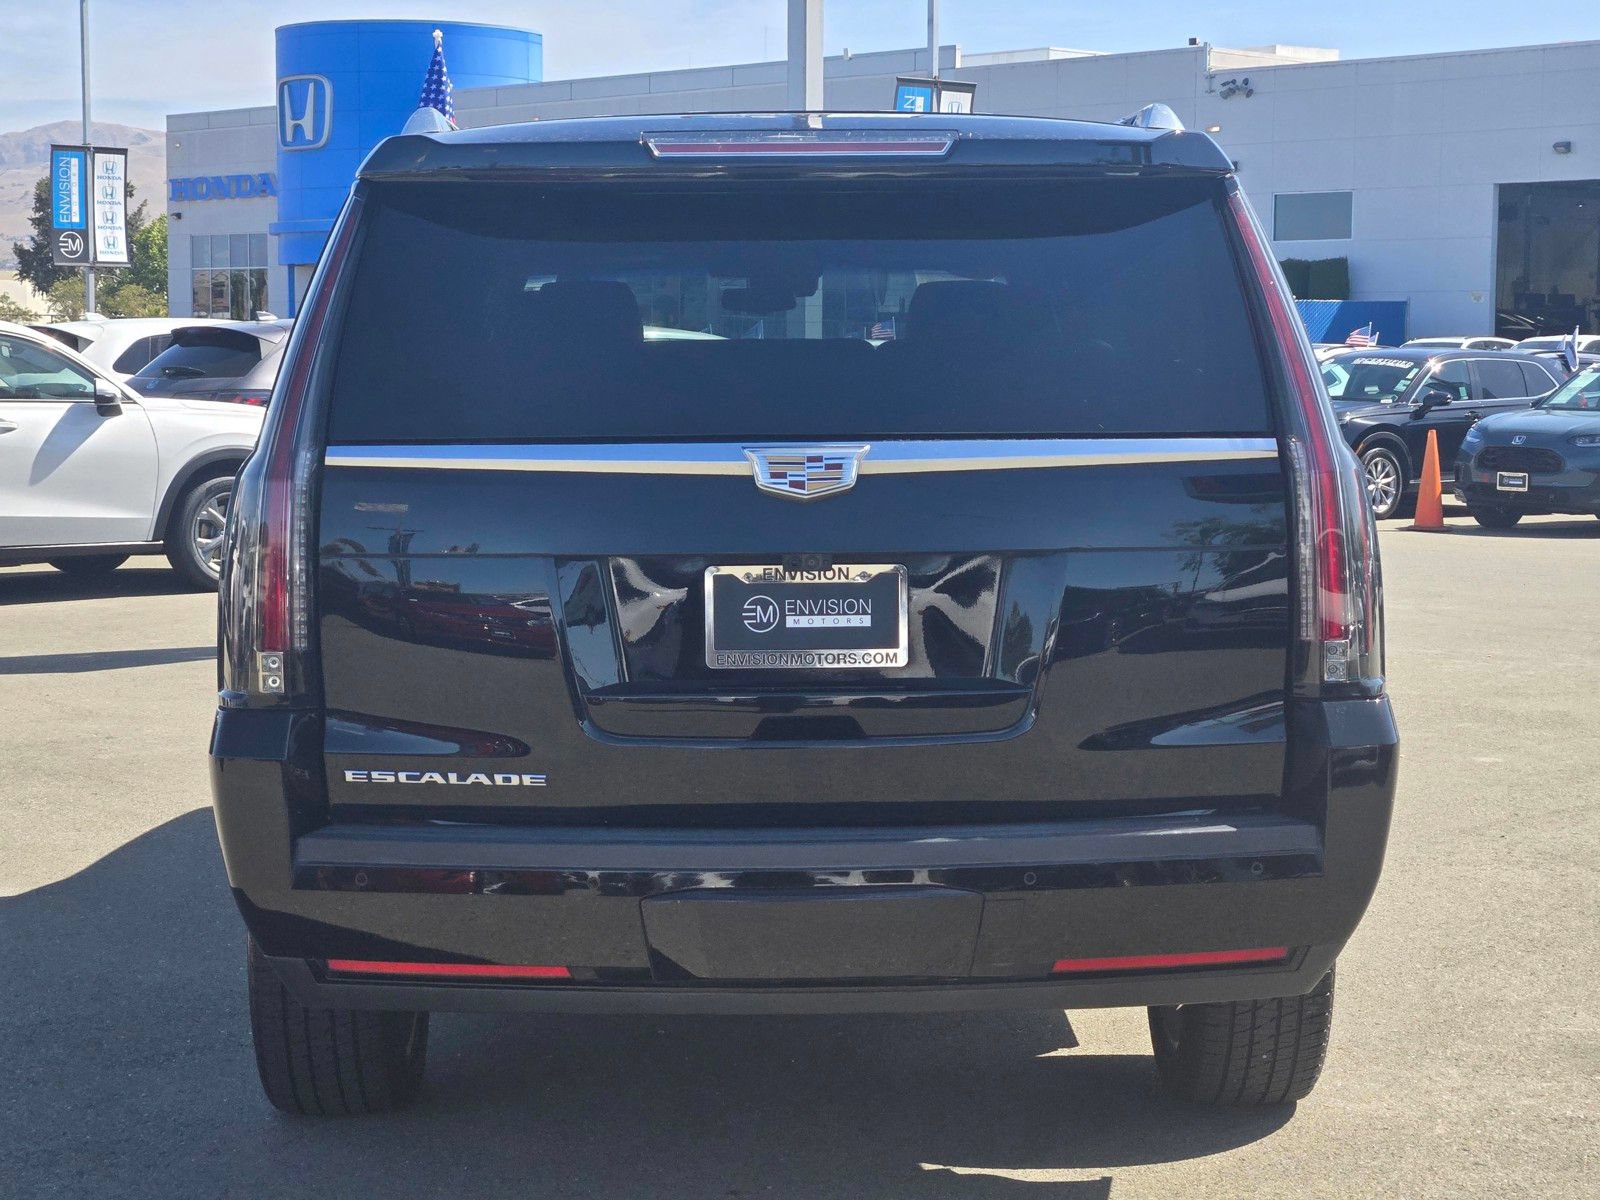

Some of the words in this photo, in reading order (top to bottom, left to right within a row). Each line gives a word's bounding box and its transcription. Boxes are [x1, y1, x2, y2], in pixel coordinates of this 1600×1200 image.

[59, 157, 71, 222] ENVISION
[168, 173, 277, 201] HONDA
[763, 566, 850, 581] ENVISION
[785, 598, 872, 615] ENVISION
[793, 617, 864, 625] MOTORS
[716, 652, 898, 666] ENVISIONMOTORS.COM
[344, 770, 547, 786] ESCALADE
